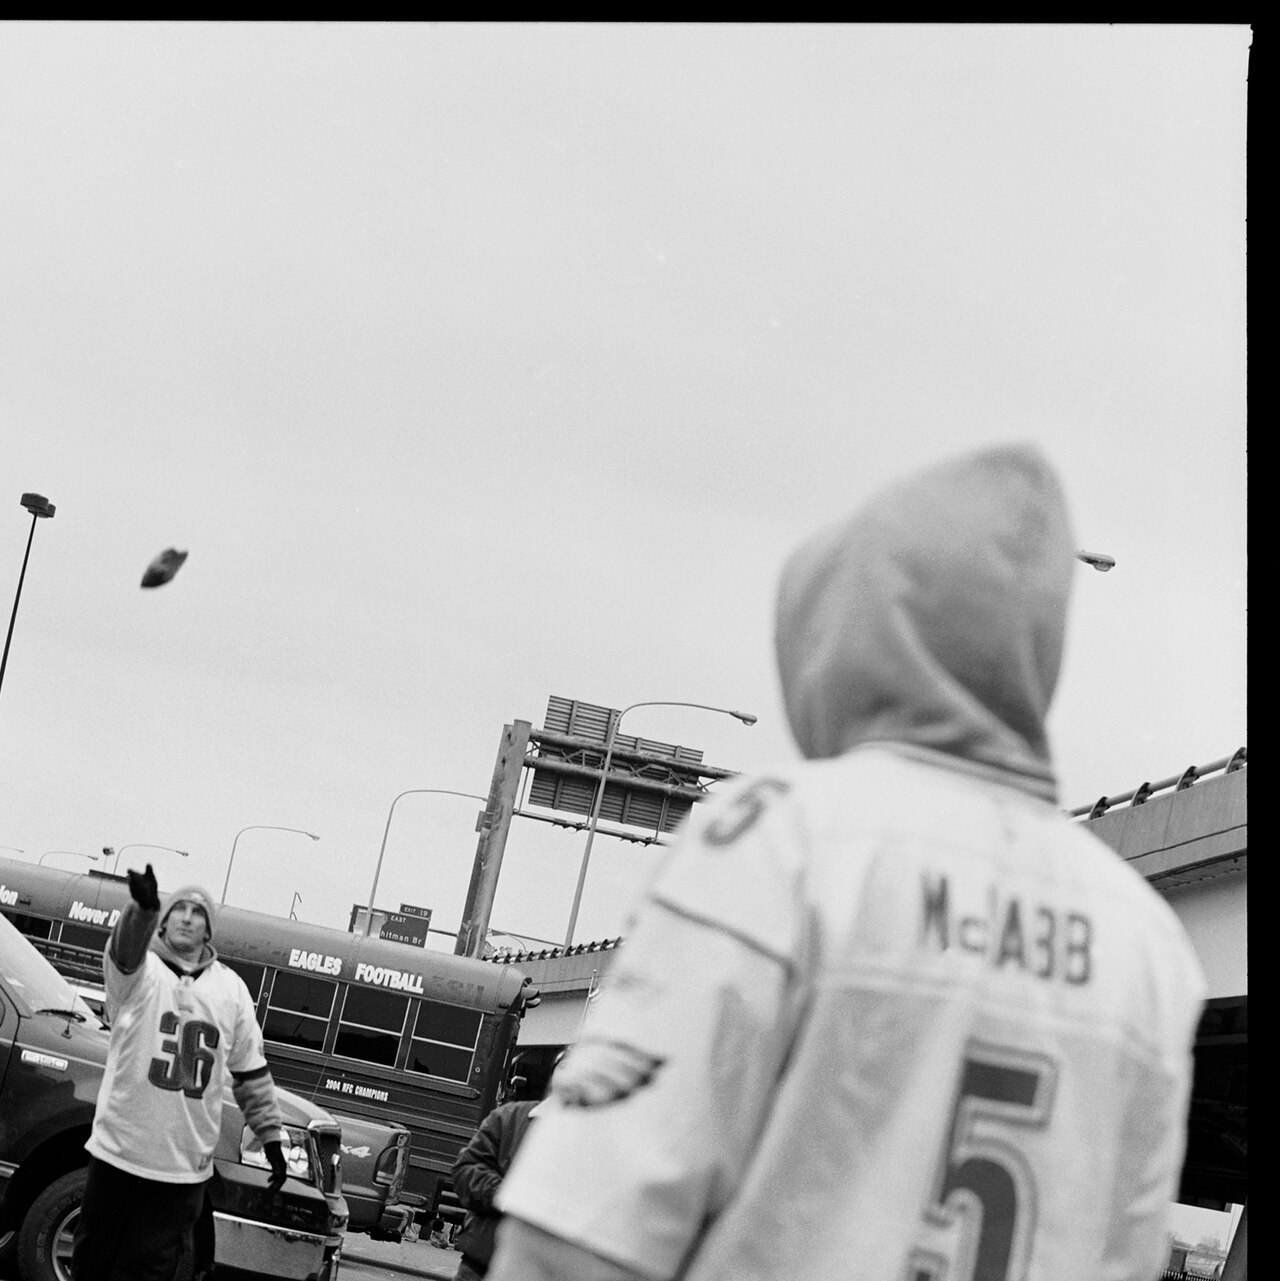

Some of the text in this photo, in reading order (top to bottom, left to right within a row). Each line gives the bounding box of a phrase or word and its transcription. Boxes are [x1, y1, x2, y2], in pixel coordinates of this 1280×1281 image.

[68, 901, 122, 928] Never D
[390, 915, 407, 924] EAST
[404, 906, 428, 917] EXIT 19
[380, 930, 409, 943] hitman
[920, 873, 1094, 985] McABB
[288, 948, 343, 976] EAGLES
[354, 963, 424, 994] FOOTBALL
[148, 1011, 220, 1100] 36
[325, 1079, 389, 1102] 2004 NFC CHAMPIONS
